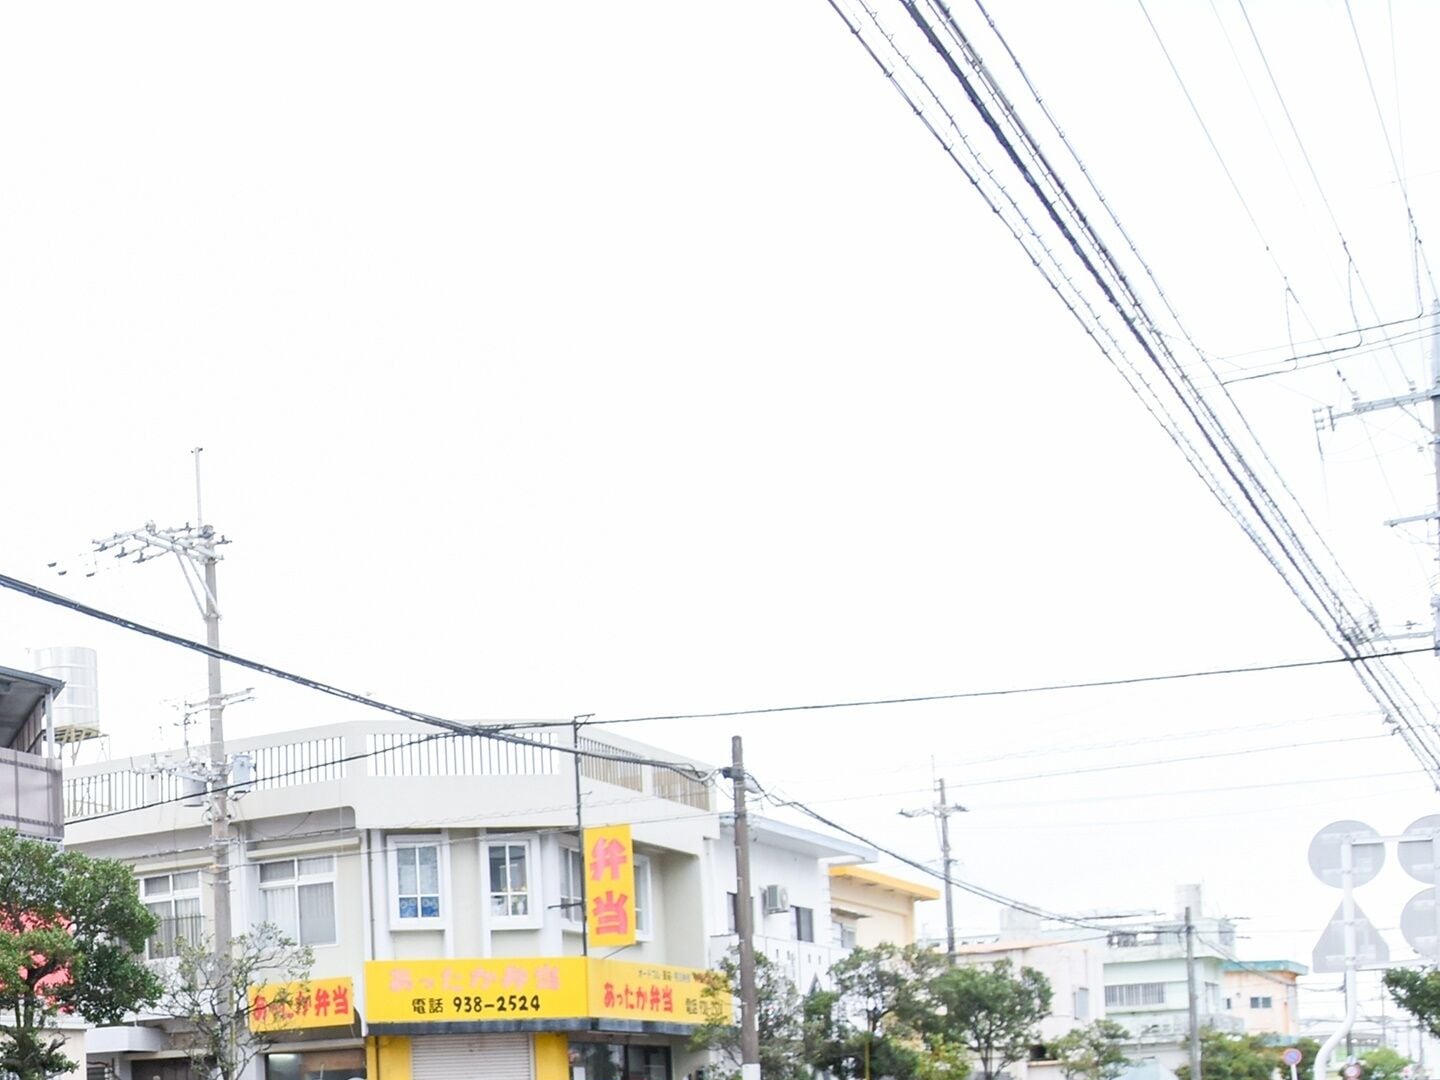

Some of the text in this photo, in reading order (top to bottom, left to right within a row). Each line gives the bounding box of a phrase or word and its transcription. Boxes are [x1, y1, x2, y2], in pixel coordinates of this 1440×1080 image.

[590, 836, 628, 935] 弁当
[389, 965, 561, 992] あったか弁当
[412, 995, 541, 1014] 電話 938-2524
[603, 982, 674, 1014] あったか弁当
